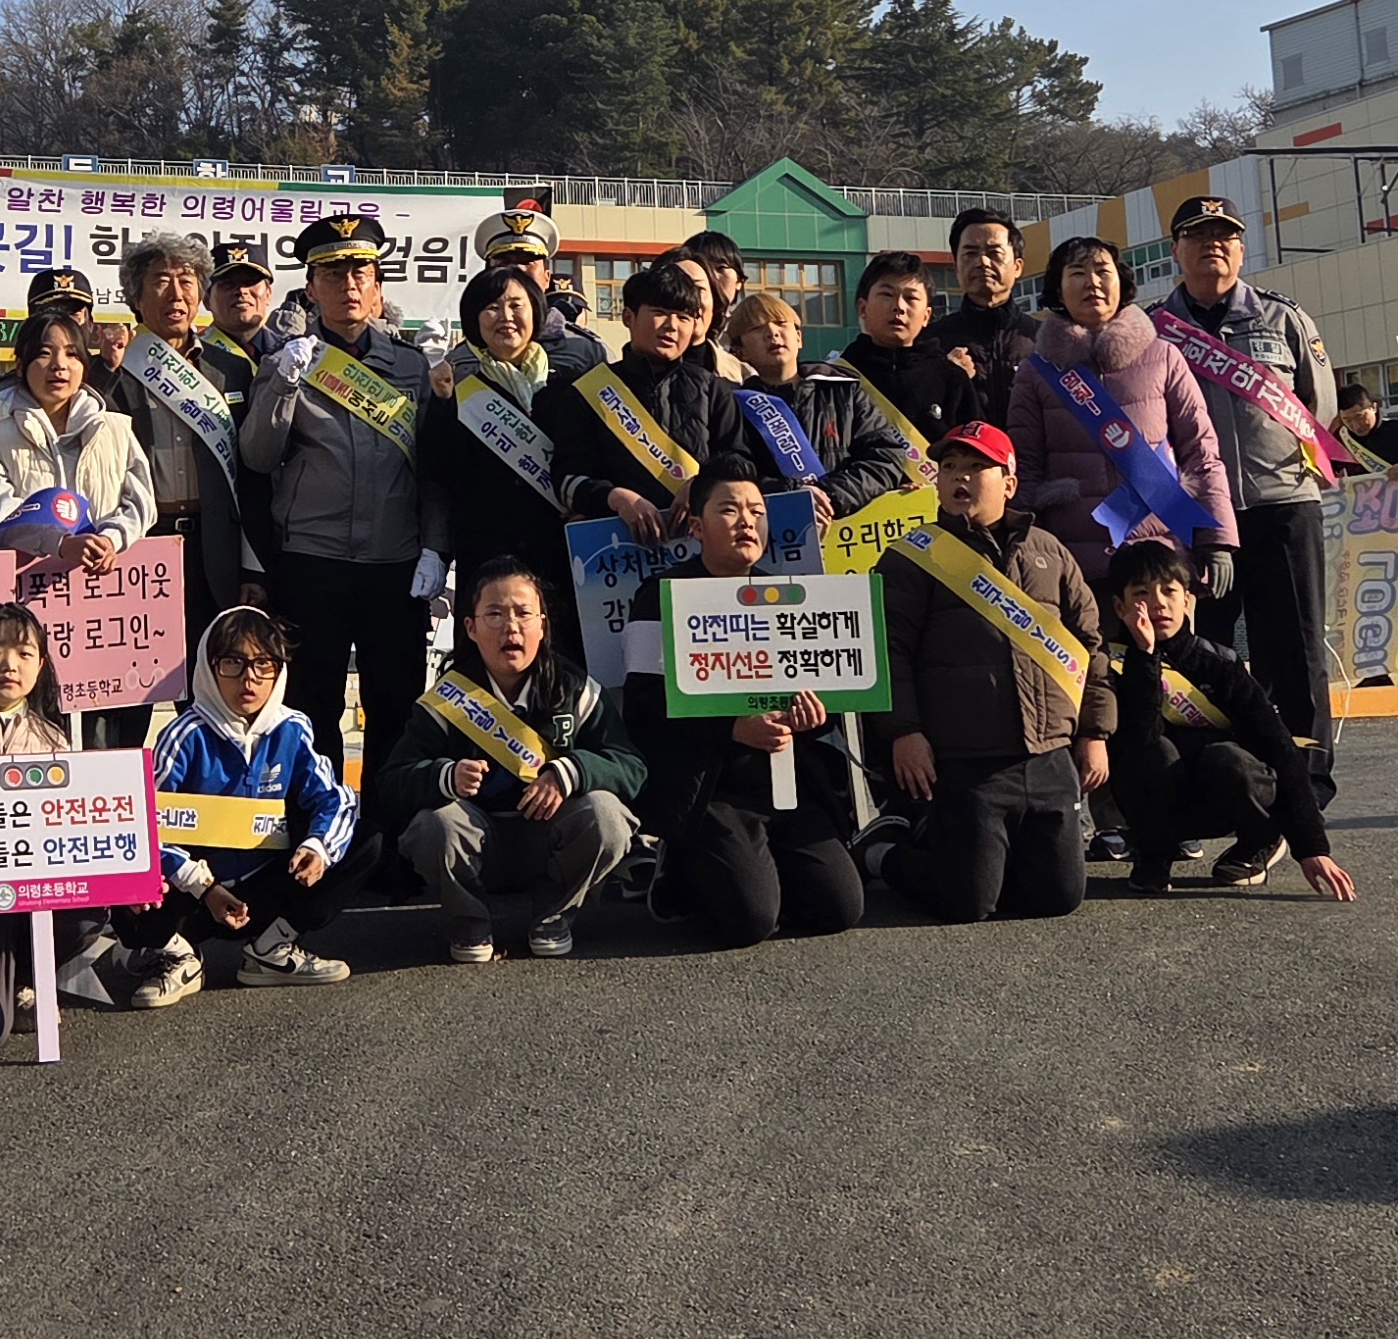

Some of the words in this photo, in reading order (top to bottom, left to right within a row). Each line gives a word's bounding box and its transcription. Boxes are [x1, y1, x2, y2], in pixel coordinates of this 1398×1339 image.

[7, 185, 64, 214] 알찬
[80, 188, 167, 218] 행복한
[148, 341, 200, 391] 안전한
[343, 363, 383, 397] 안전한
[143, 367, 180, 398] 우리
[179, 398, 217, 435] 함께
[315, 369, 390, 427] 스쿨존에서는
[1060, 370, 1102, 417] 멈춰!
[486, 398, 537, 445] 안전한
[598, 385, 641, 436] 친구사랑
[637, 433, 674, 469] YES
[748, 395, 804, 471] 학교폭력!
[481, 421, 518, 454] 우리
[518, 453, 553, 492] 함께
[16, 571, 71, 609] 폭력
[83, 563, 171, 601] 로그아웃
[47, 621, 75, 659] 랑
[85, 613, 165, 651] 로그인~
[687, 614, 771, 643] 안전띠는
[776, 611, 860, 640] 확실하게
[971, 574, 1032, 629] 친구사랑
[1031, 626, 1069, 664] YES
[689, 650, 773, 682] 정지선은
[777, 648, 863, 678] 정확하게
[437, 681, 495, 731] 친구사랑
[494, 727, 534, 764] YES
[553, 714, 574, 747] P
[41, 794, 135, 827] 안전운전
[43, 833, 137, 865] 안전보행
[18, 881, 89, 899] 의령초등학교
